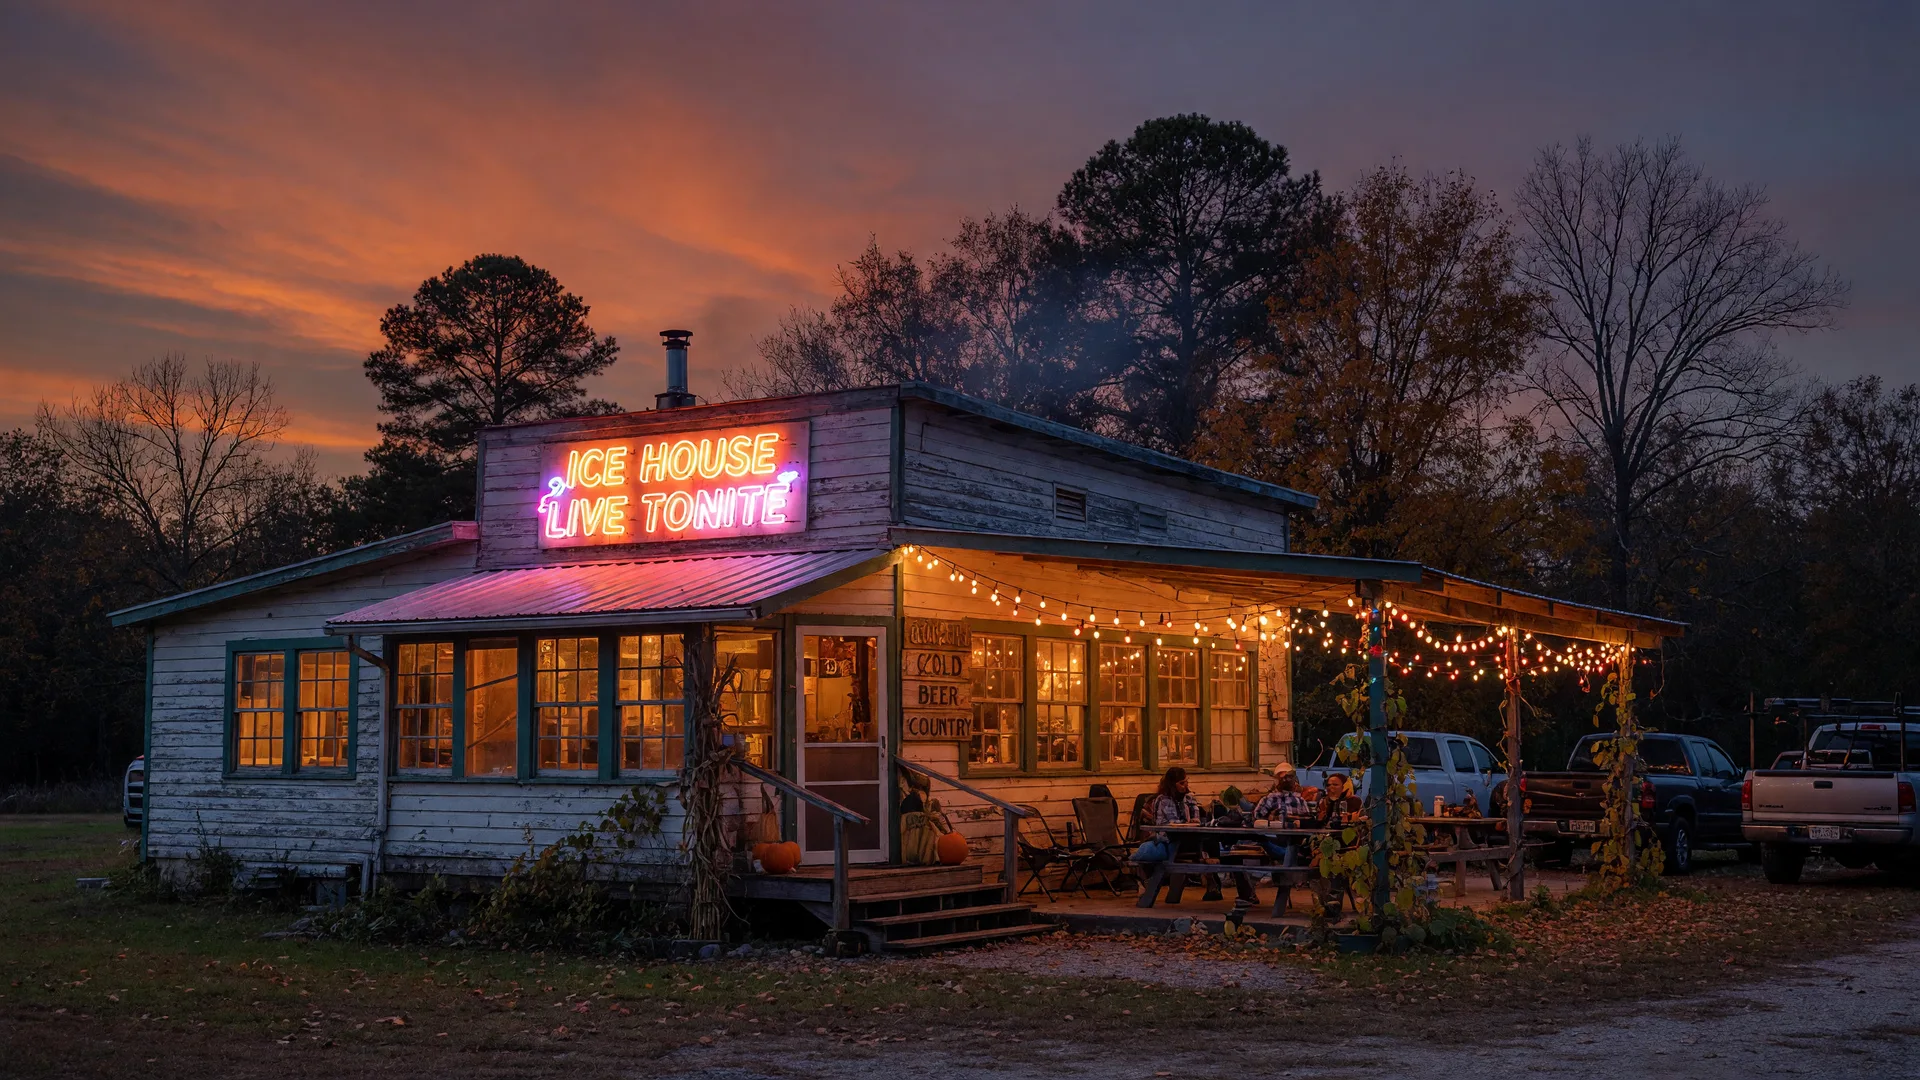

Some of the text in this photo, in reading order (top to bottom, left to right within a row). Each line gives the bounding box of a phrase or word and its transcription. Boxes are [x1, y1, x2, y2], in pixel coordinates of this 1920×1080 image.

[565, 432, 780, 489] ICE HOUSE
[545, 482, 790, 538] LIVE TONITE
[918, 685, 959, 706] BEER
[908, 717, 972, 737] COUNTRY
